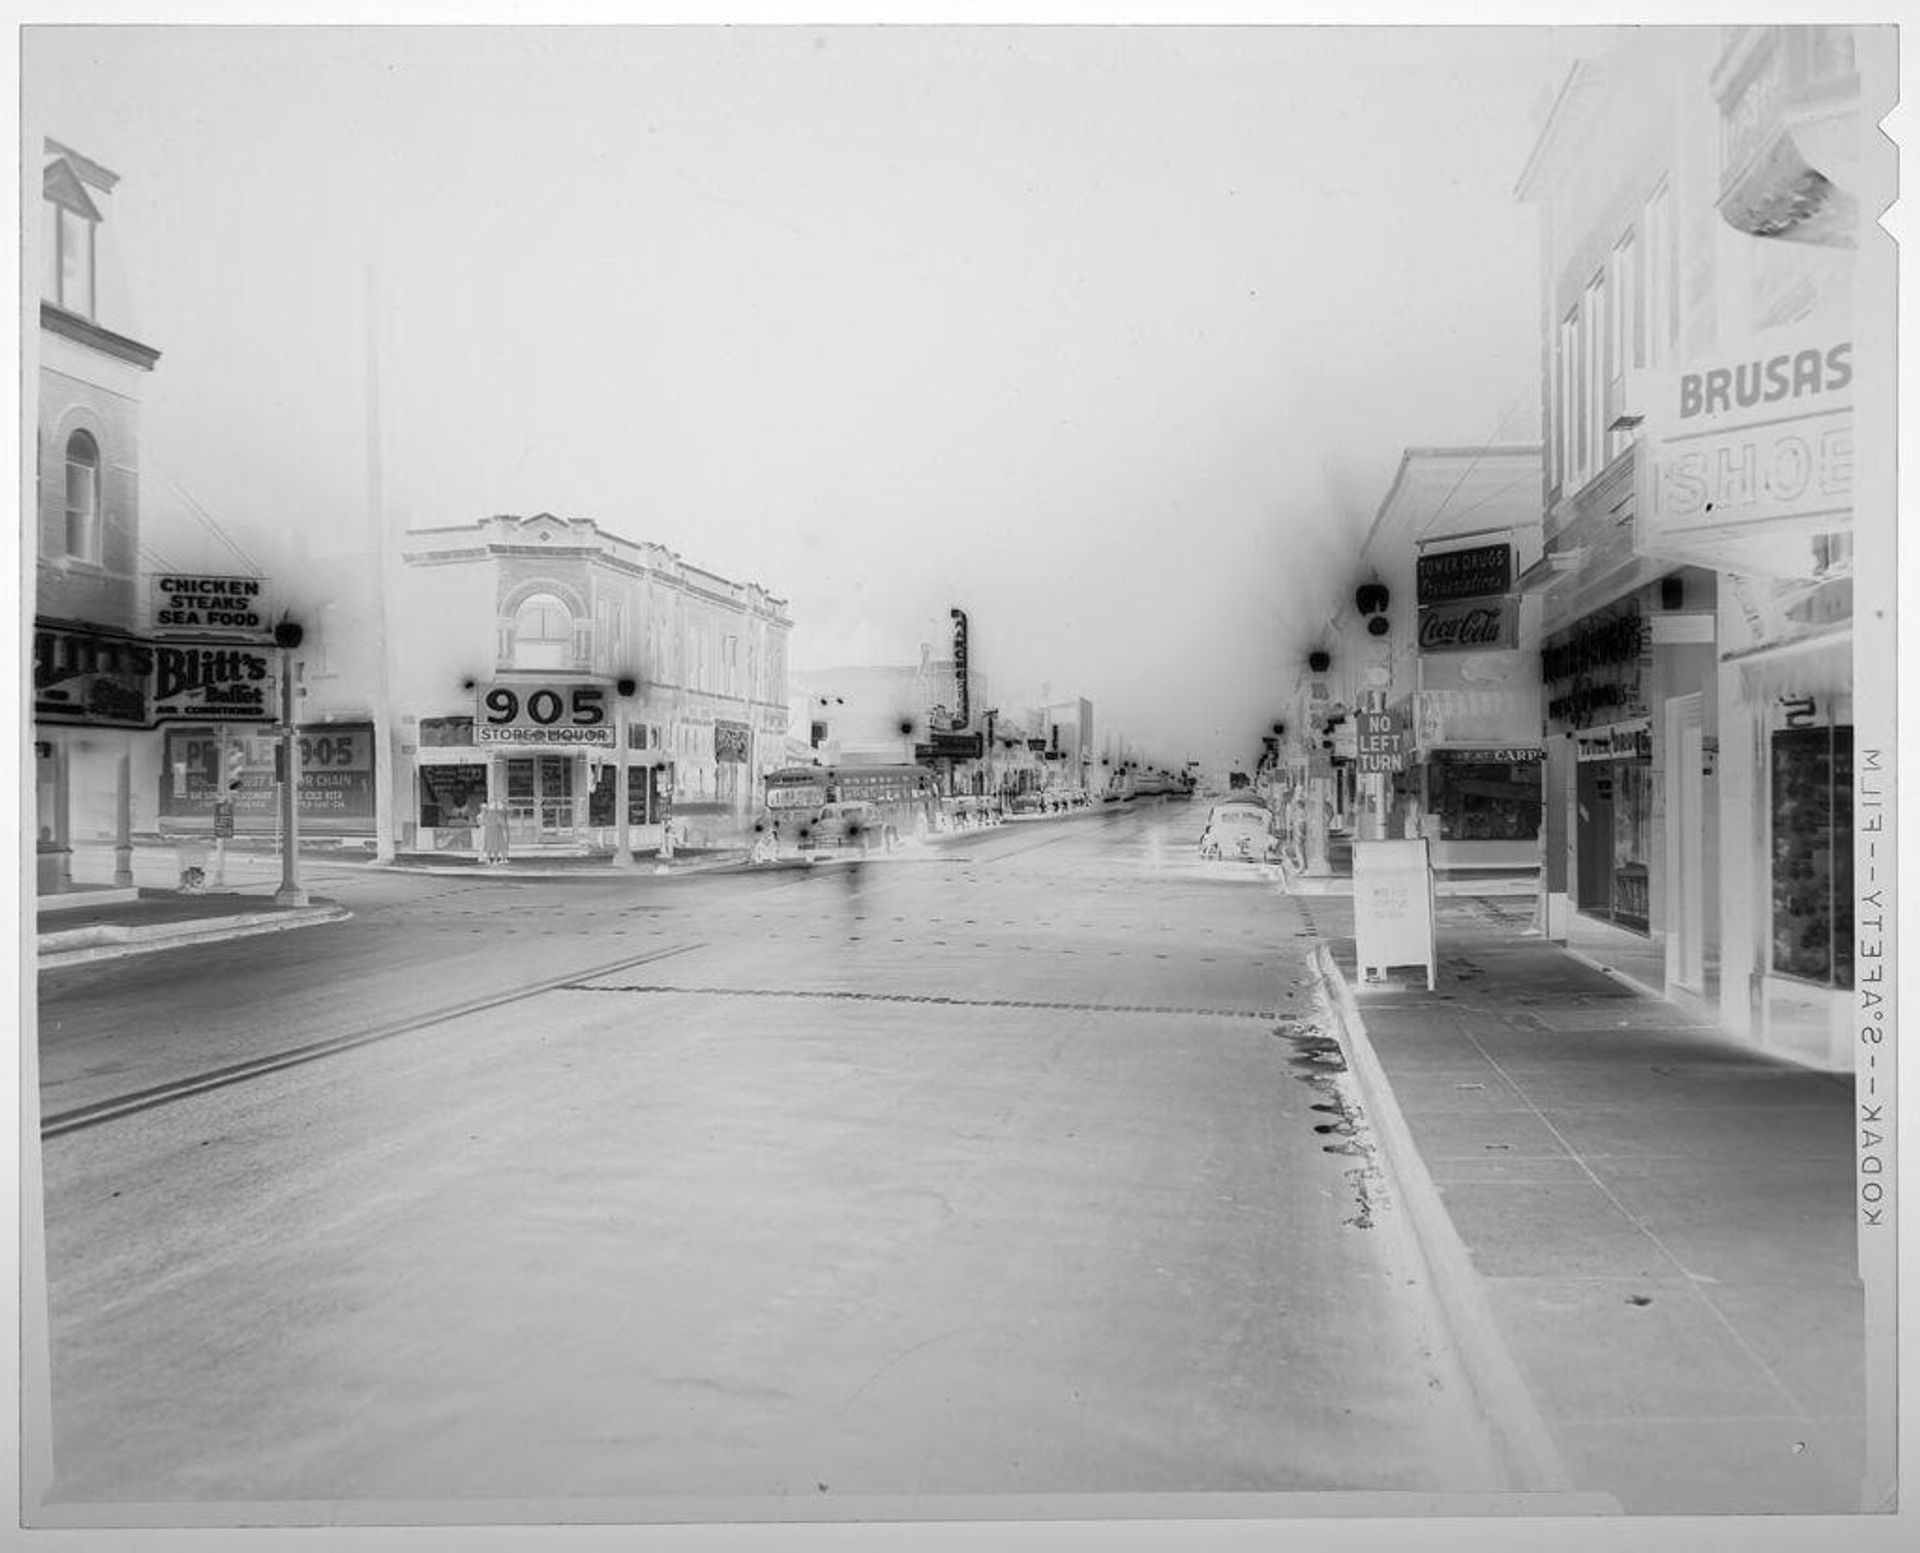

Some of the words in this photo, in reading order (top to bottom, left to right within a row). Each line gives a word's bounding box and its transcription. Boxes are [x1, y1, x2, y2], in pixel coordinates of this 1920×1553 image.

[1680, 342, 1853, 419] BRUSAS
[1462, 550, 1504, 570] DRUGS
[159, 578, 259, 596] CHICKEN
[169, 594, 251, 610] STEAKS
[157, 610, 201, 625] SEA
[206, 611, 260, 627] FOOD
[485, 688, 604, 726] 905
[1369, 715, 1391, 733] NO
[1360, 735, 1400, 751] LEFT
[1361, 754, 1402, 771] TURN
